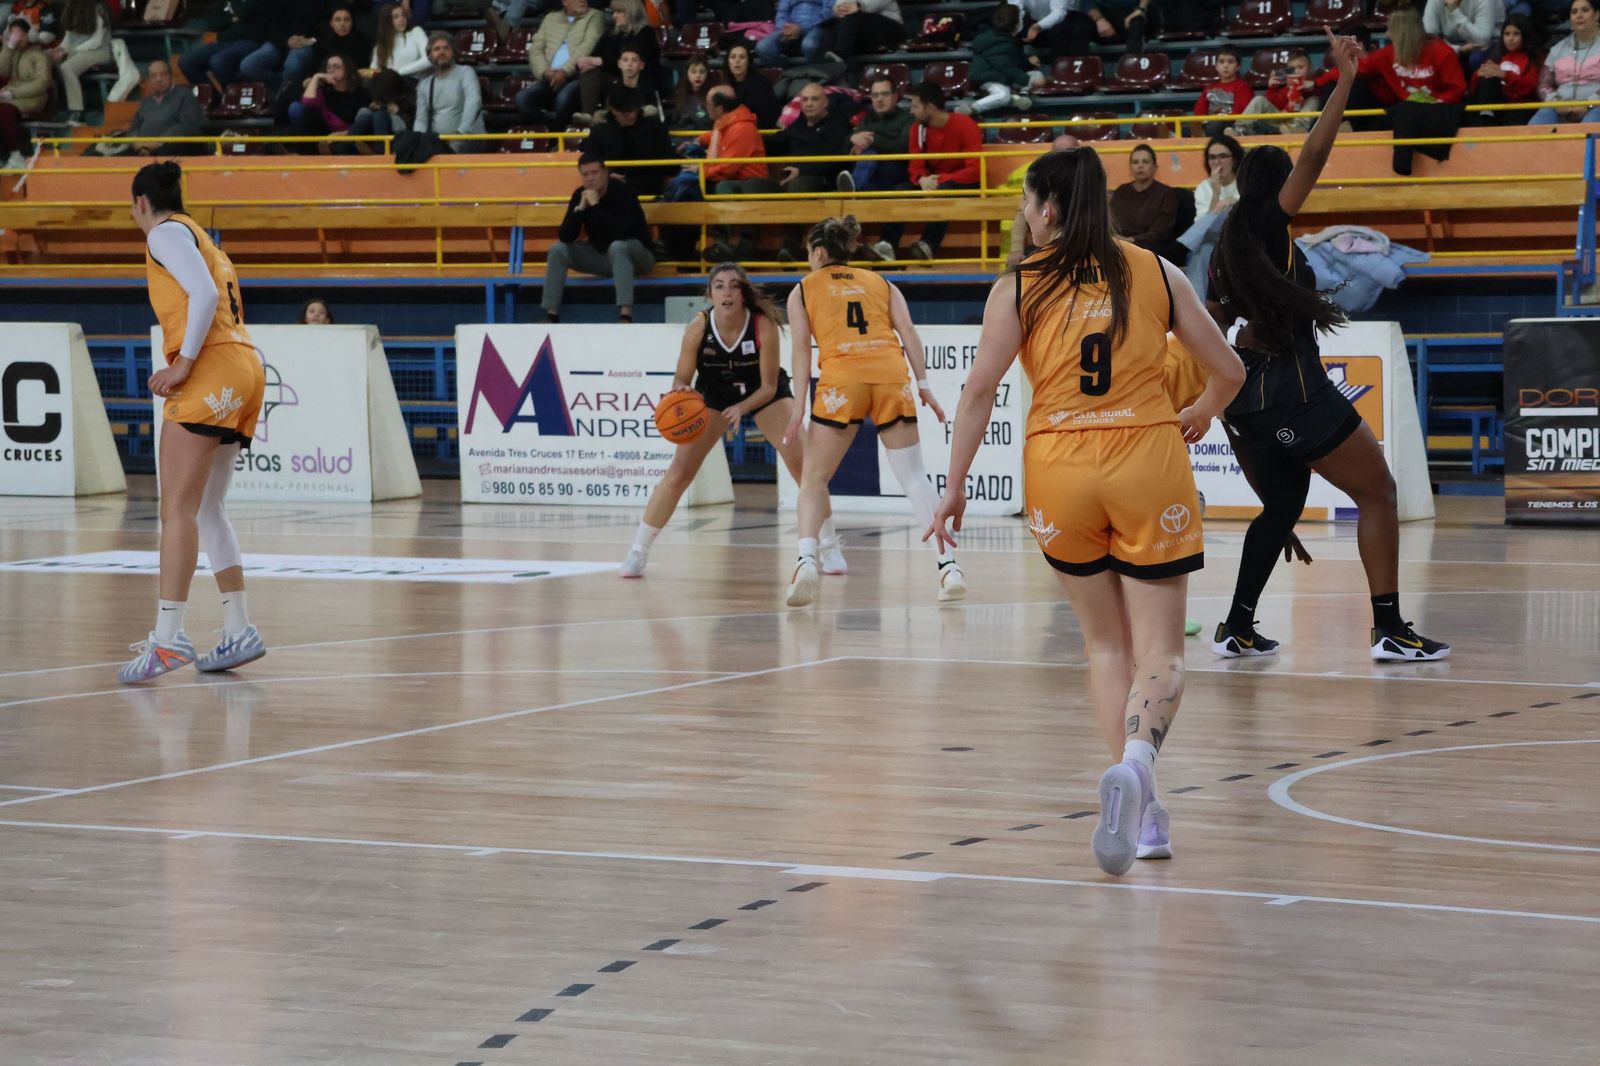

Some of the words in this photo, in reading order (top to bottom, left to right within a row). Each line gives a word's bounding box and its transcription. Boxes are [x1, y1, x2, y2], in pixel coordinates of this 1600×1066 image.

[1257, 1, 1272, 14] 11
[1073, 61, 1083, 73] 7
[847, 301, 868, 335] 4
[925, 346, 956, 369] LUIS
[1080, 333, 1112, 396] 9
[570, 392, 666, 411] ARIA
[4, 448, 63, 462] CRUCES
[468, 447, 506, 458] Avenida
[508, 448, 528, 458] Tres
[530, 449, 563, 458] Cruces
[566, 450, 576, 459] 17
[291, 447, 353, 475] salud
[492, 482, 515, 494] 980
[519, 482, 535, 495] 05
[538, 482, 554, 496] 85
[558, 483, 573, 496] 90
[586, 483, 610, 497] 605
[614, 484, 630, 497] 76
[634, 484, 648, 497] 71
[1527, 501, 1574, 509] TENEMOS
[1577, 501, 1598, 509] LOS
